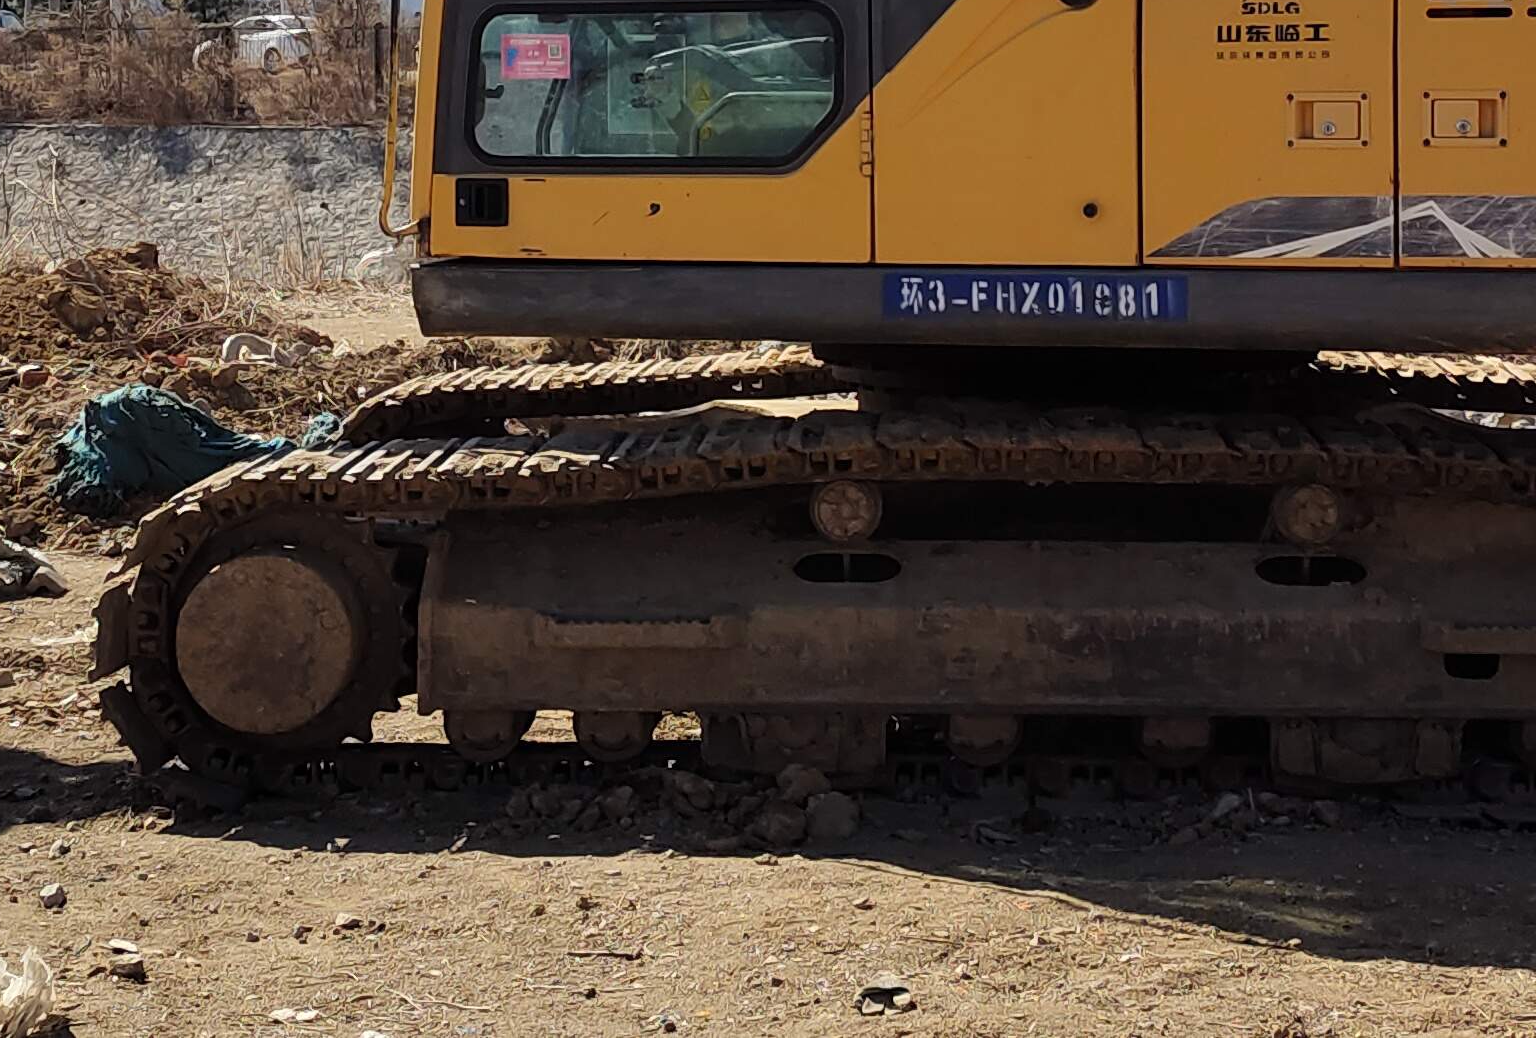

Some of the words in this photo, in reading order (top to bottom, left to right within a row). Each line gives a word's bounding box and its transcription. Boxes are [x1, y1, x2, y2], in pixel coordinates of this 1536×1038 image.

[1241, 1, 1300, 15] SDLG
[1217, 23, 1331, 43] 山东临工
